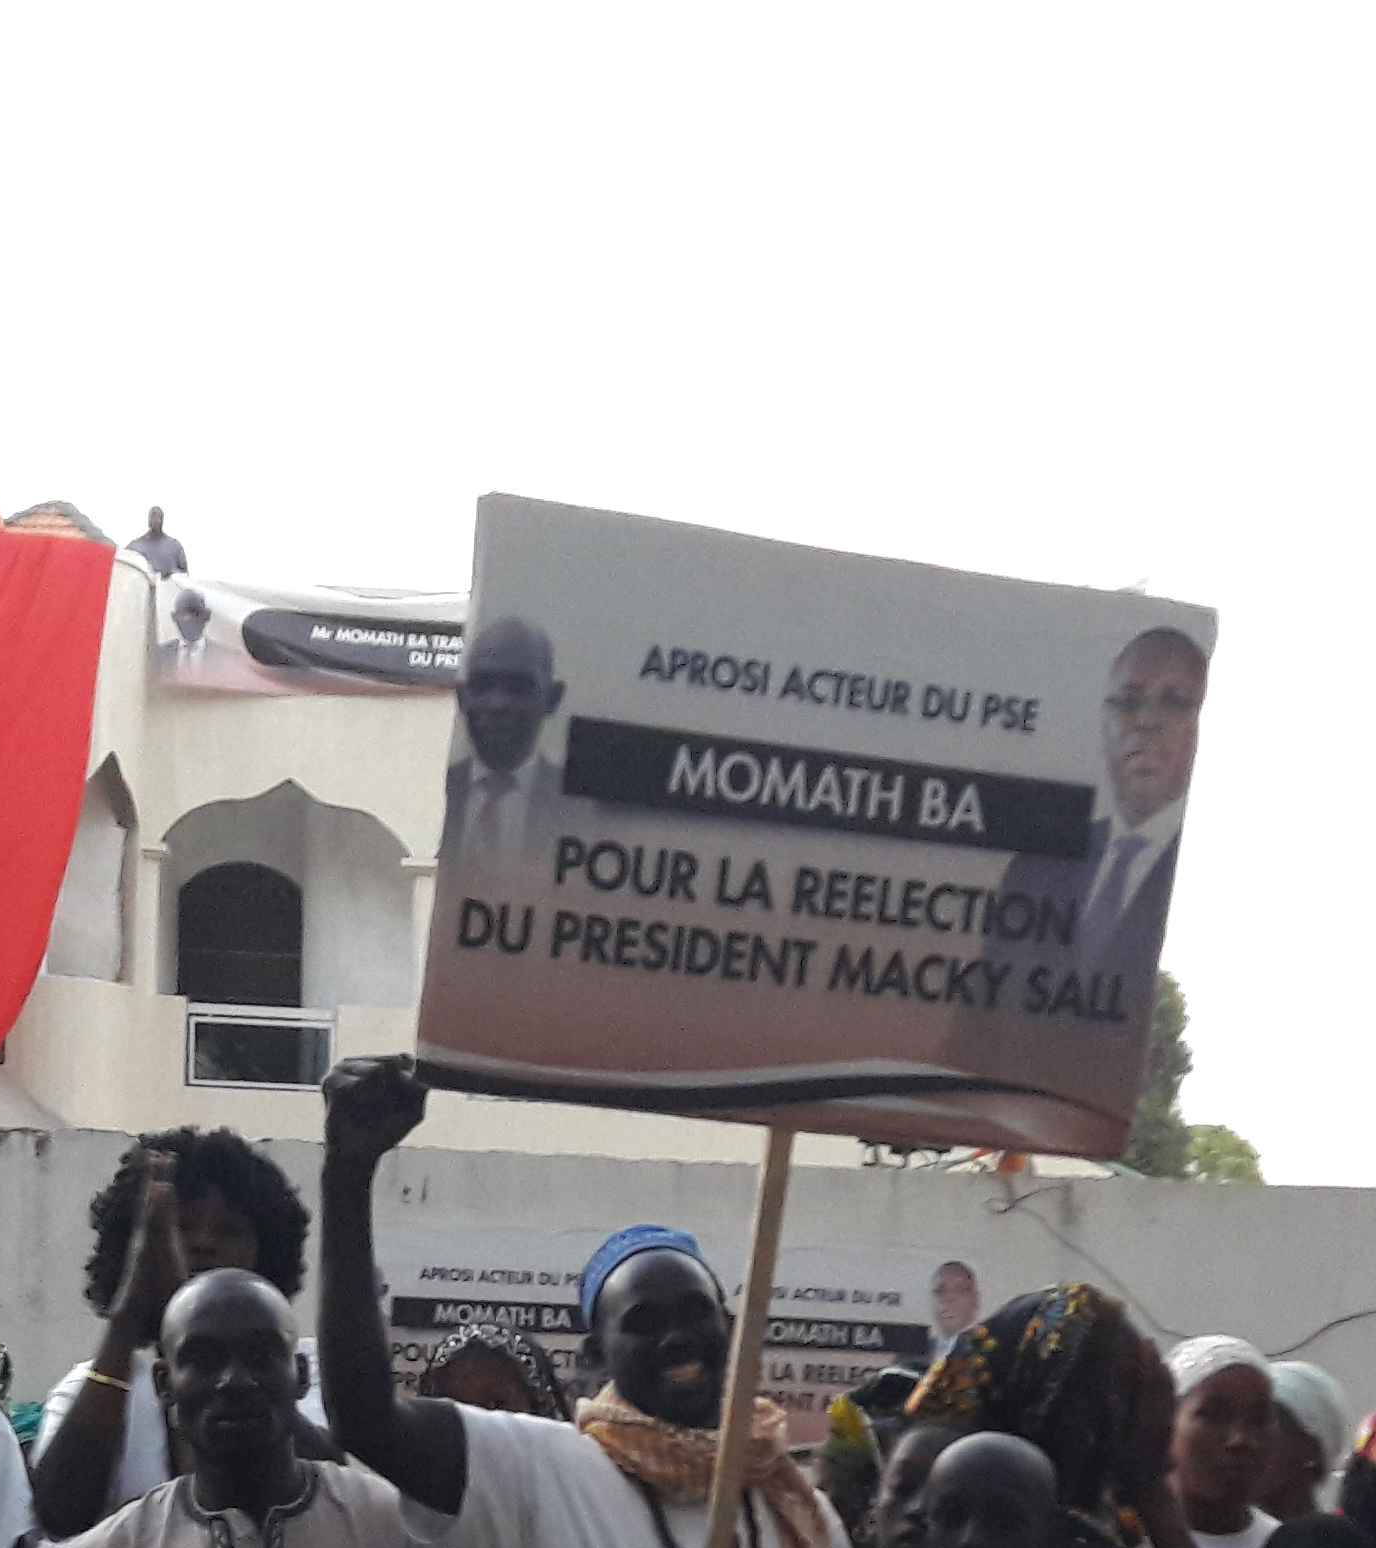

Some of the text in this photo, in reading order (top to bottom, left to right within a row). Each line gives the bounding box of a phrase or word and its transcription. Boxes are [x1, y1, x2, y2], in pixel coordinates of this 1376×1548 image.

[640, 645, 1040, 733] APROSI ACTEUR DU PSE
[667, 744, 985, 834] MOMATH BA
[555, 836, 1077, 946] POUR LA REELECTION
[460, 898, 1130, 1023] DU PRESIDENT MACKY SALL
[433, 1302, 573, 1329] MOMATH BA
[767, 1321, 849, 1346] OMATH
